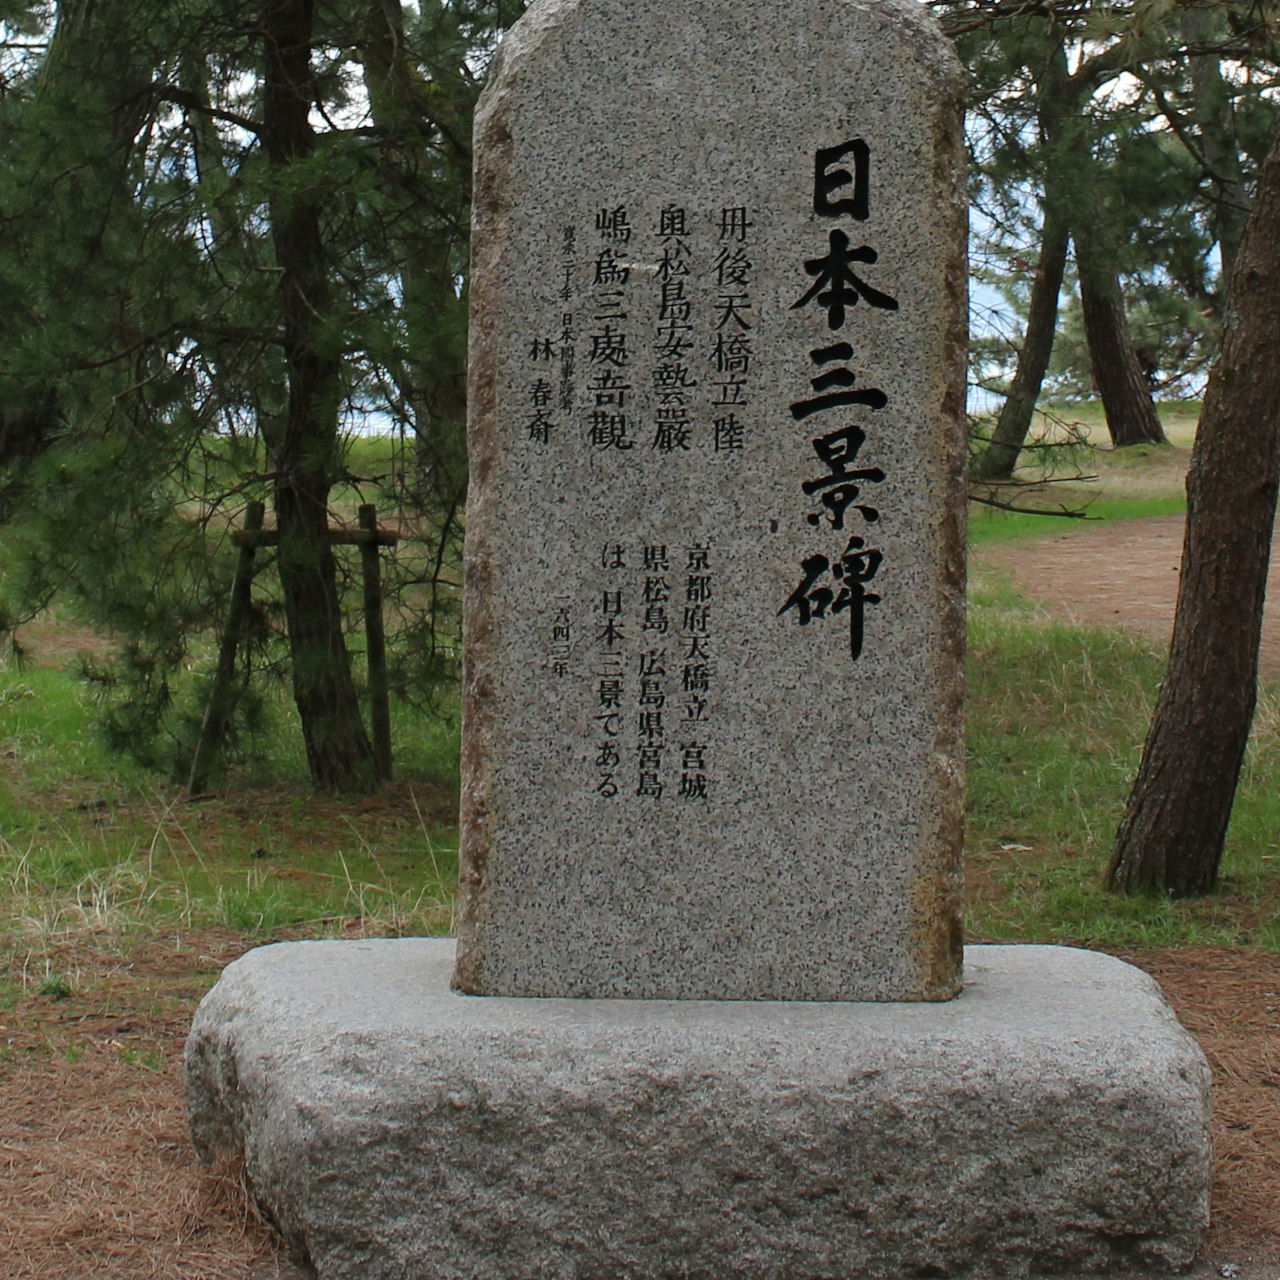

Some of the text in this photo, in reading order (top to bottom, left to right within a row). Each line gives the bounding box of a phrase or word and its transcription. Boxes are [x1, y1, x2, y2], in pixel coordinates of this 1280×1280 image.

[777, 138, 899, 661] 日本三景碑
[637, 544, 669, 800] 県松島 広島県宮島
[678, 542, 712, 801] 京都府天橋立 宮城
